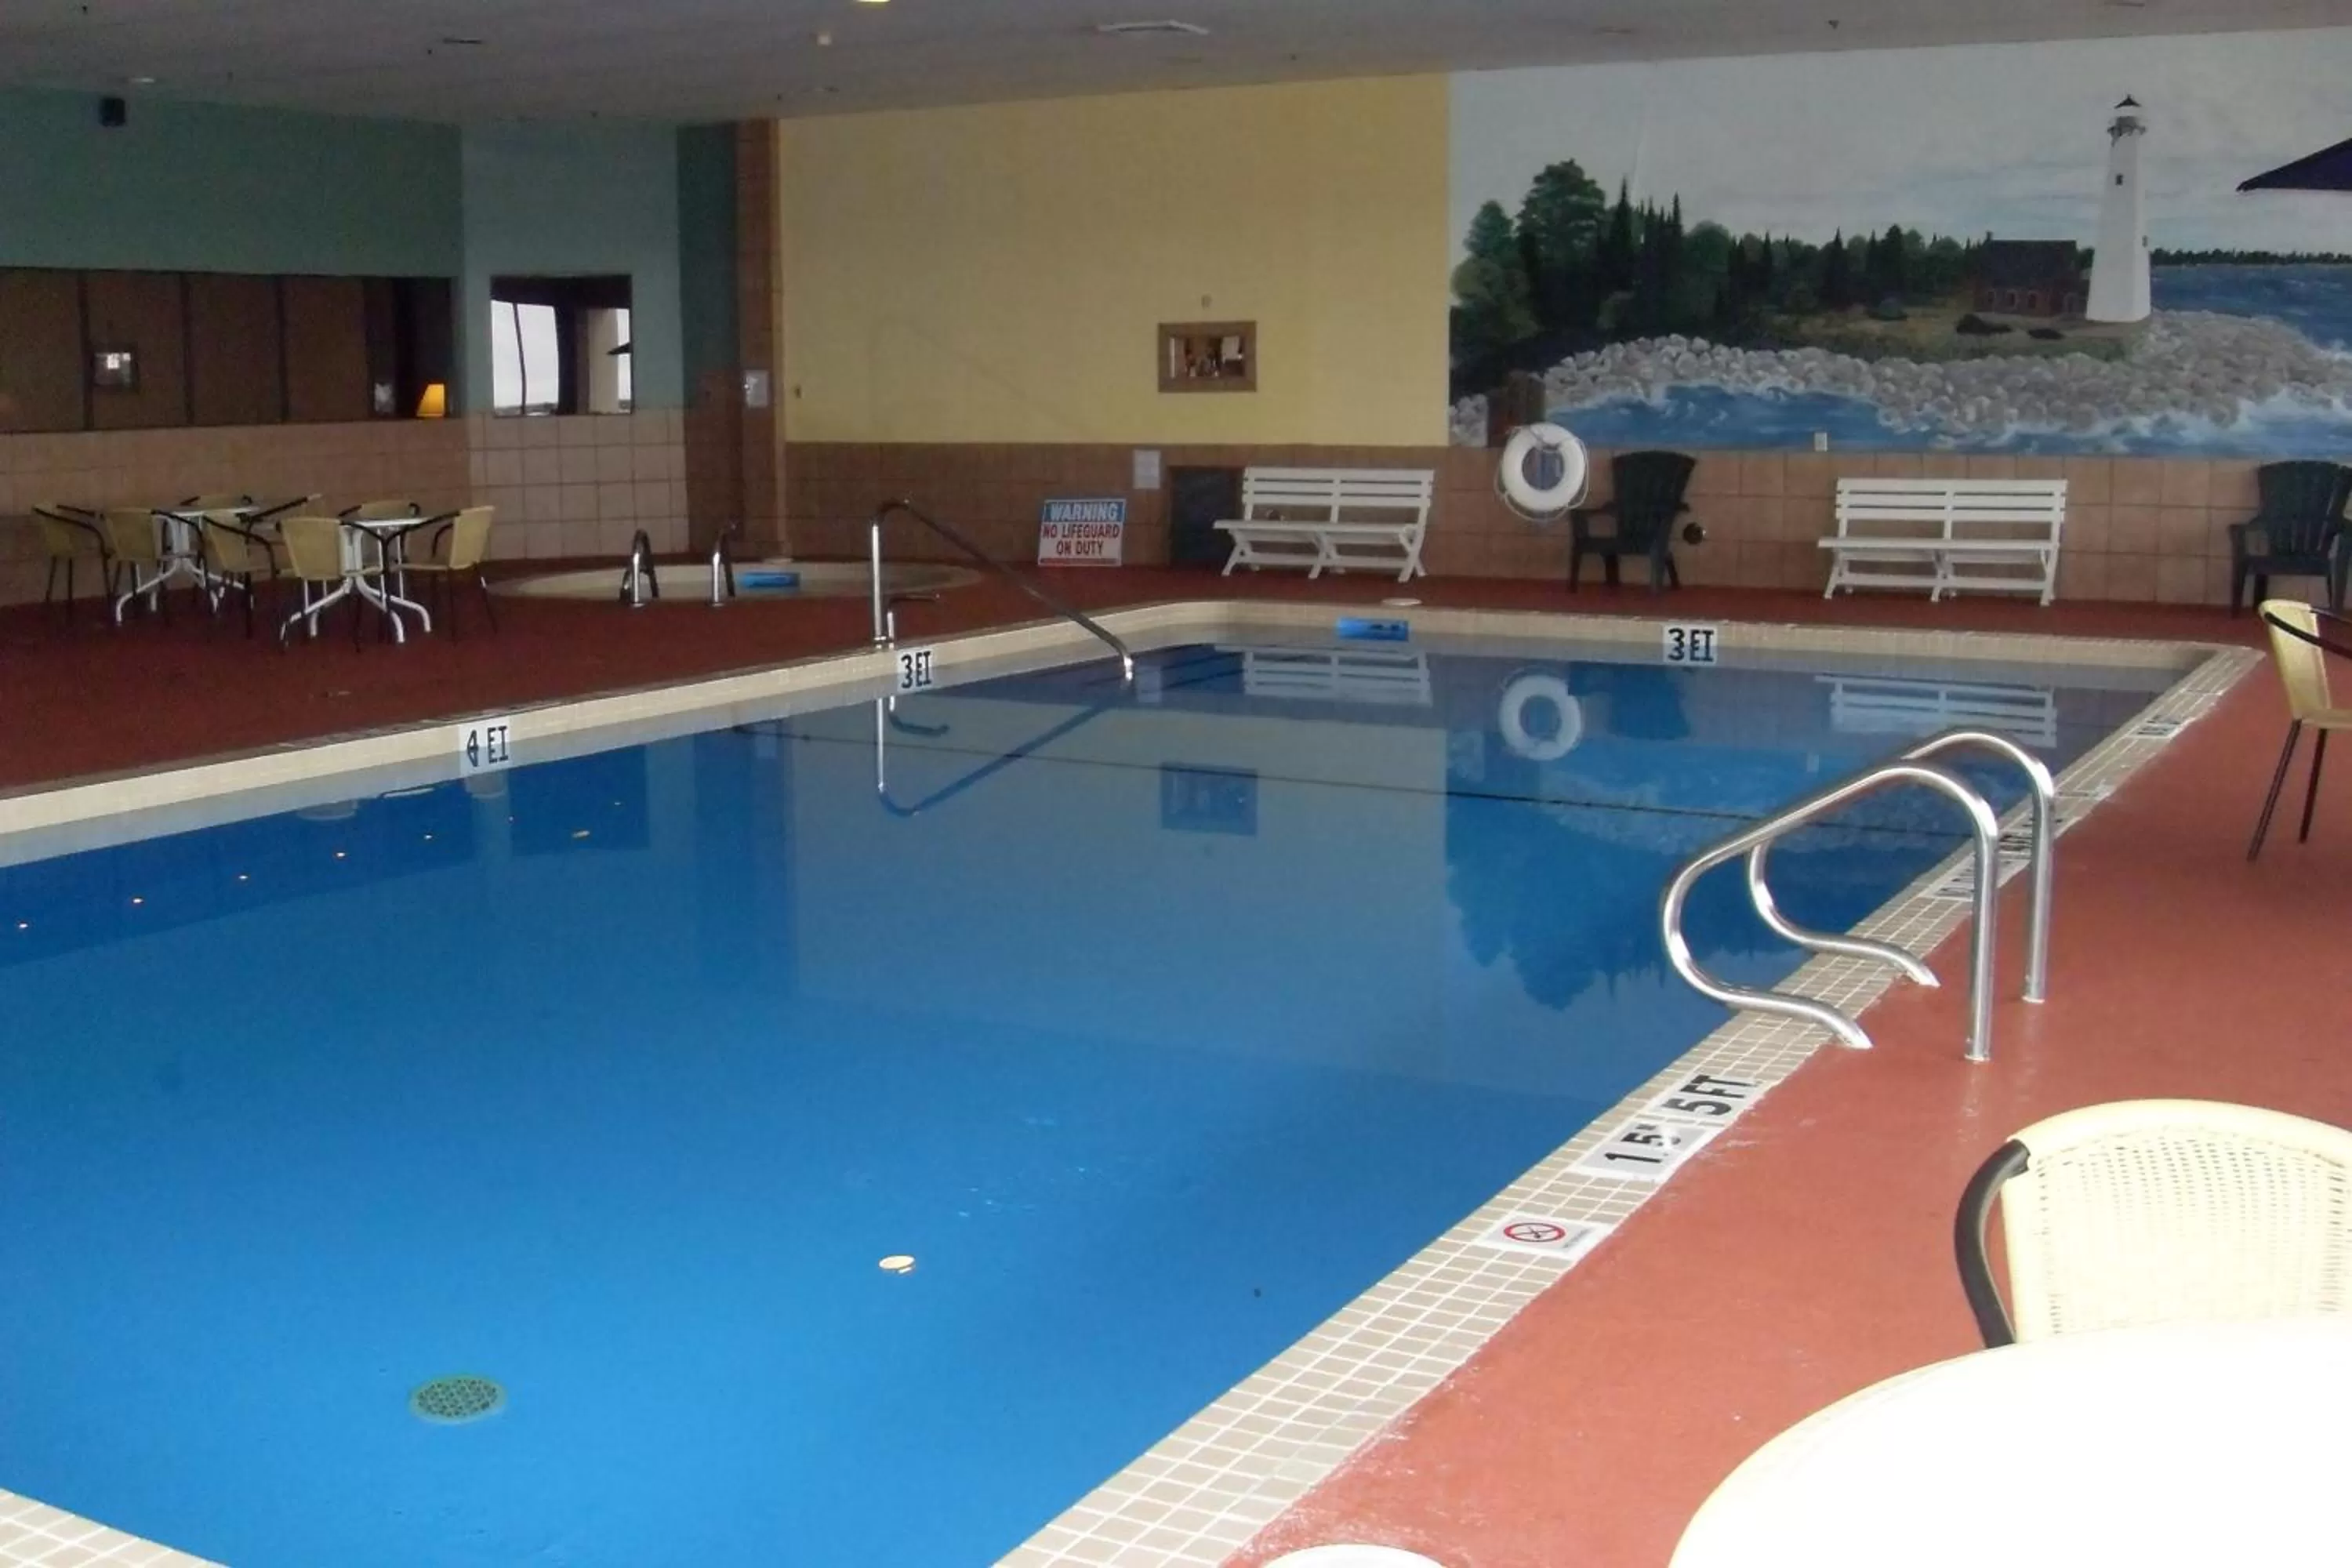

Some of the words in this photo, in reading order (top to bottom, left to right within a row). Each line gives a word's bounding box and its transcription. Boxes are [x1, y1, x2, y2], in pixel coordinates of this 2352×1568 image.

[1051, 503, 1118, 521] WARNING
[1043, 524, 1058, 538] NO
[1062, 524, 1120, 538] LIFEGUARD
[1057, 540, 1072, 555] ON
[1076, 540, 1104, 556] DUTY
